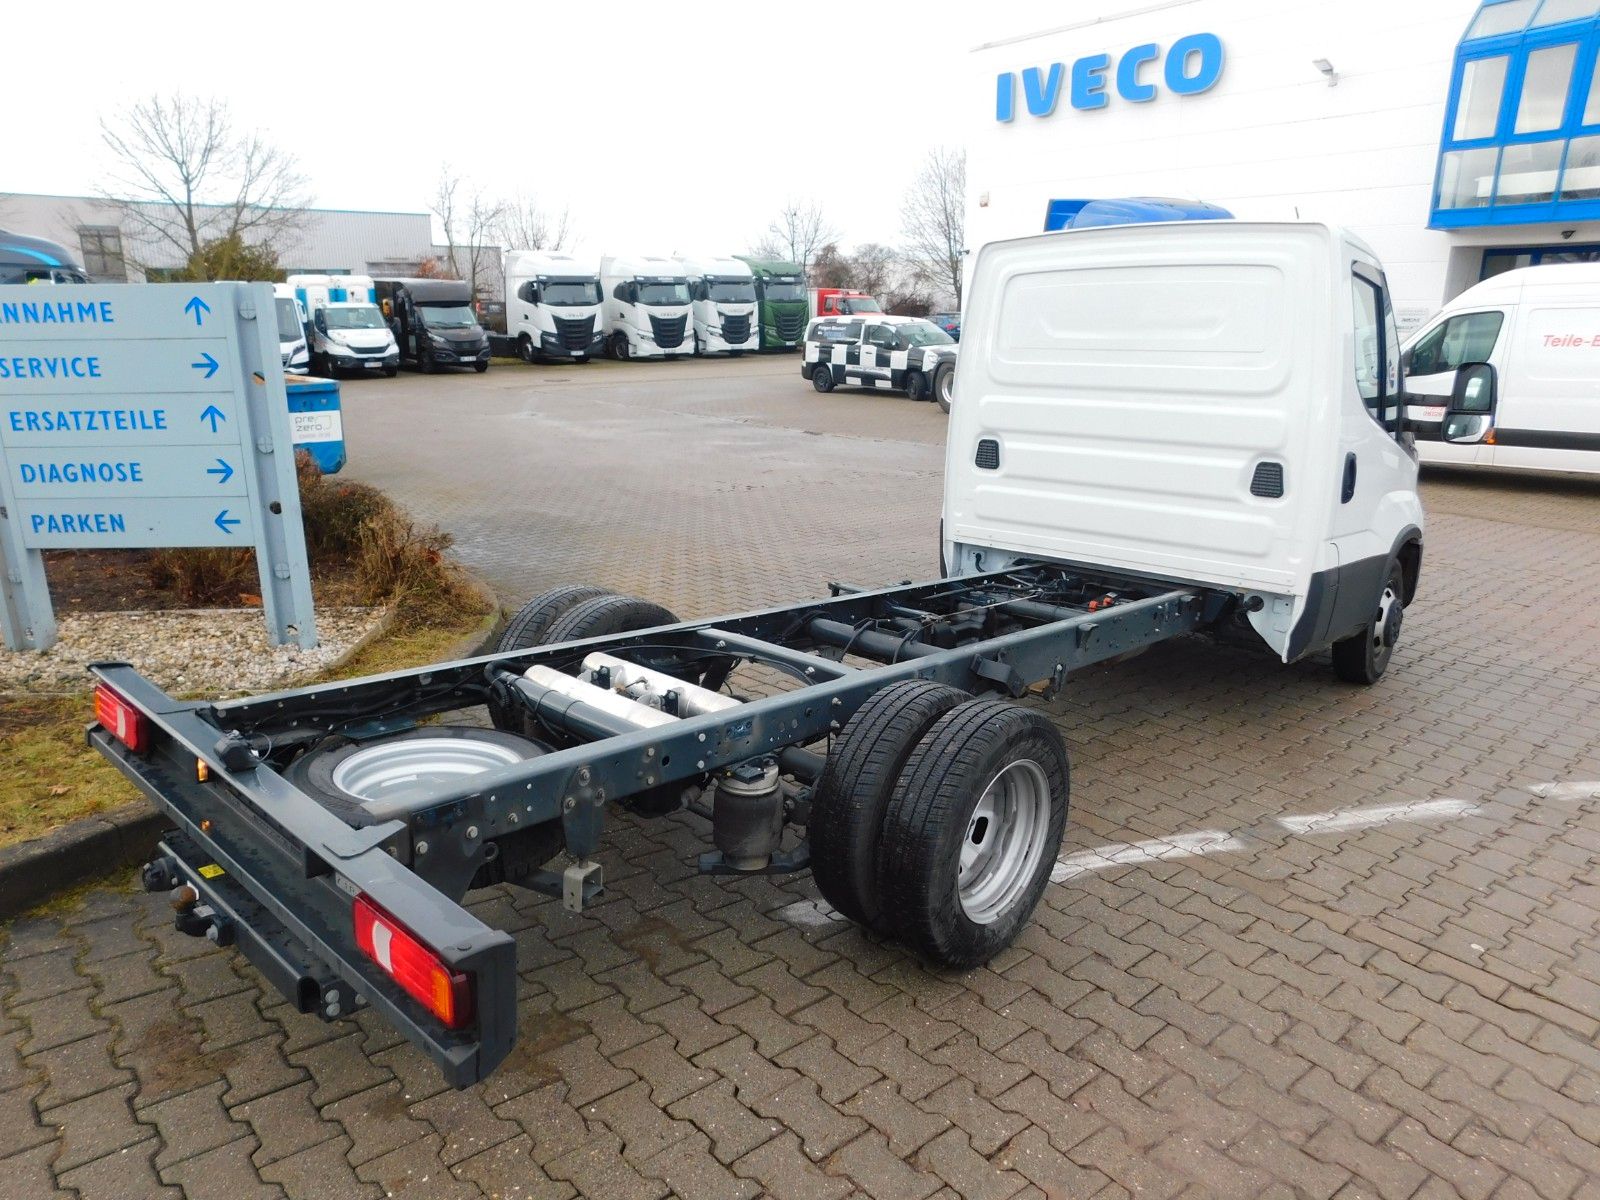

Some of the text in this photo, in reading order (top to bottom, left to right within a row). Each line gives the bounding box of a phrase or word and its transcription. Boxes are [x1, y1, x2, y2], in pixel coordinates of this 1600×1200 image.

[996, 32, 1225, 122] IVECO
[0, 301, 114, 324] NNAHME
[0, 356, 102, 378] SERVICE
[9, 408, 168, 432] ERSATZTEILE
[20, 462, 143, 483] DIAGNOSE
[31, 513, 126, 534] PARKEN
